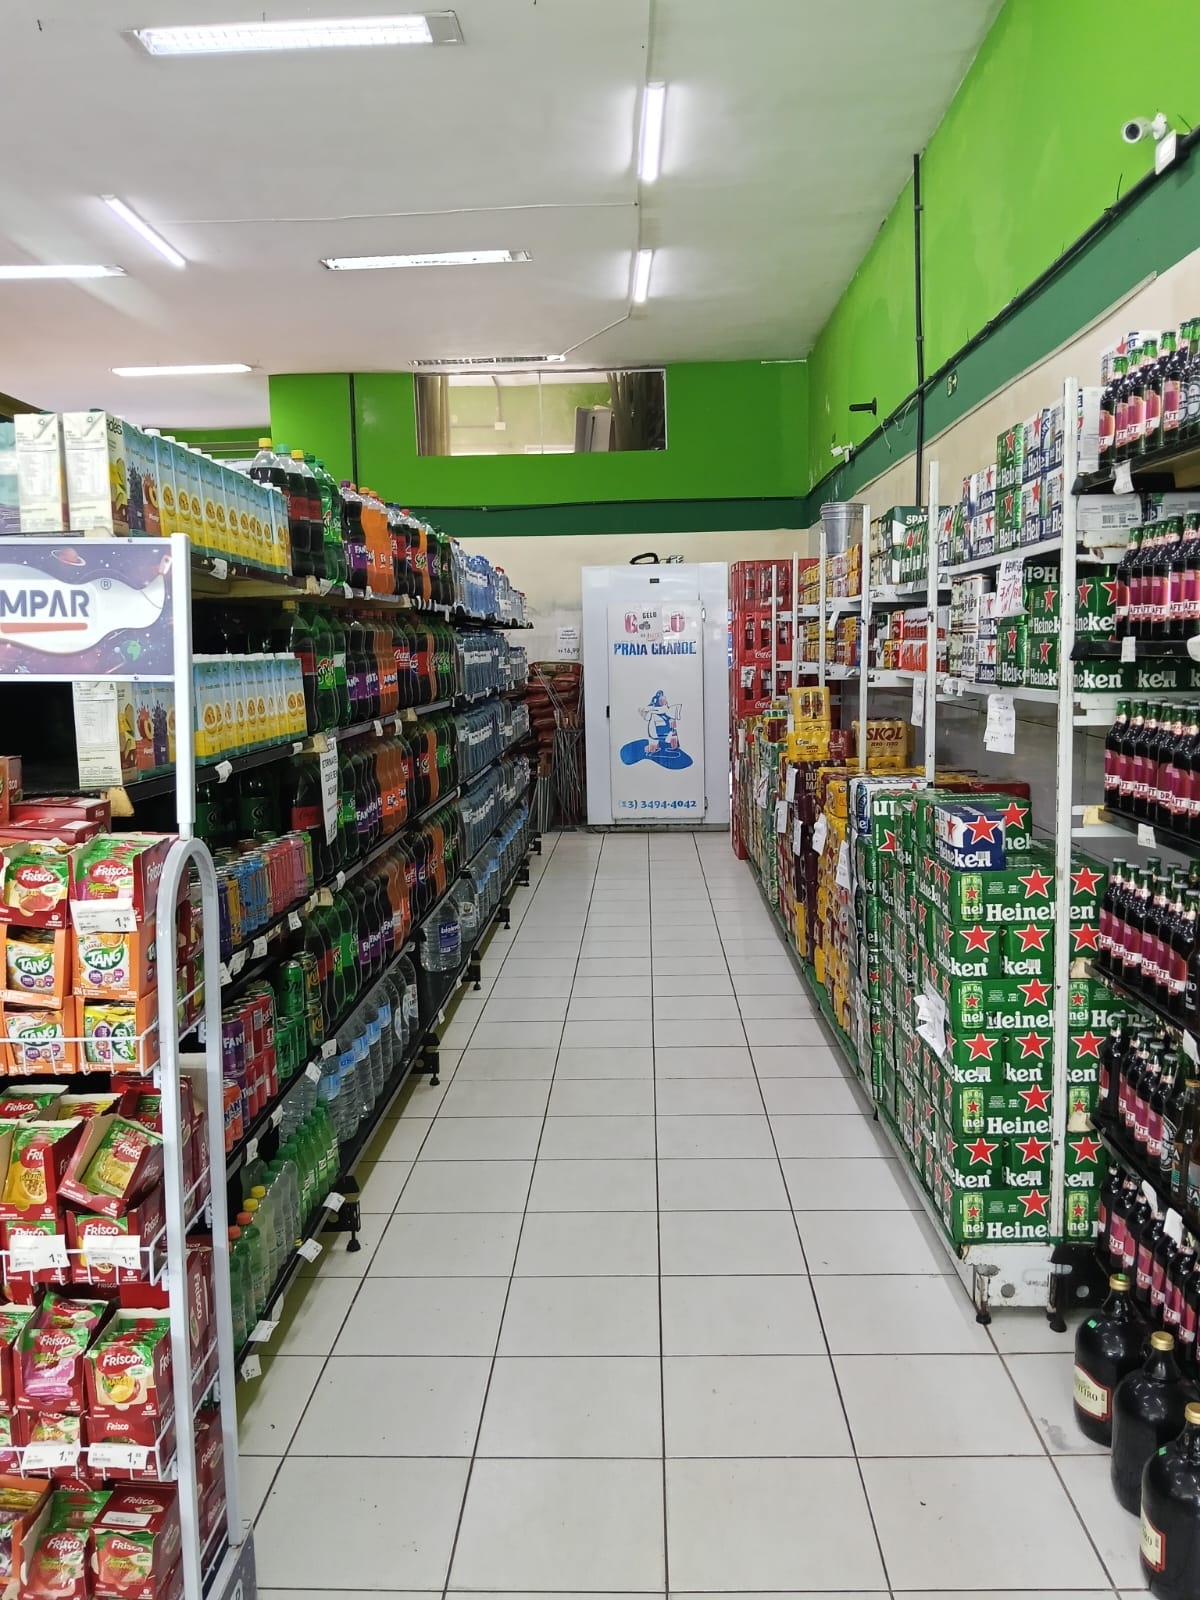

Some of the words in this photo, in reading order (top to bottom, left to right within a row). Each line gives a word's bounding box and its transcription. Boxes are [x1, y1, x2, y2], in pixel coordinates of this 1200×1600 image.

[613, 643, 648, 656] PRAIA
[866, 727, 903, 741] SKOL
[88, 949, 122, 967] TANG
[19, 958, 50, 973] TANG
